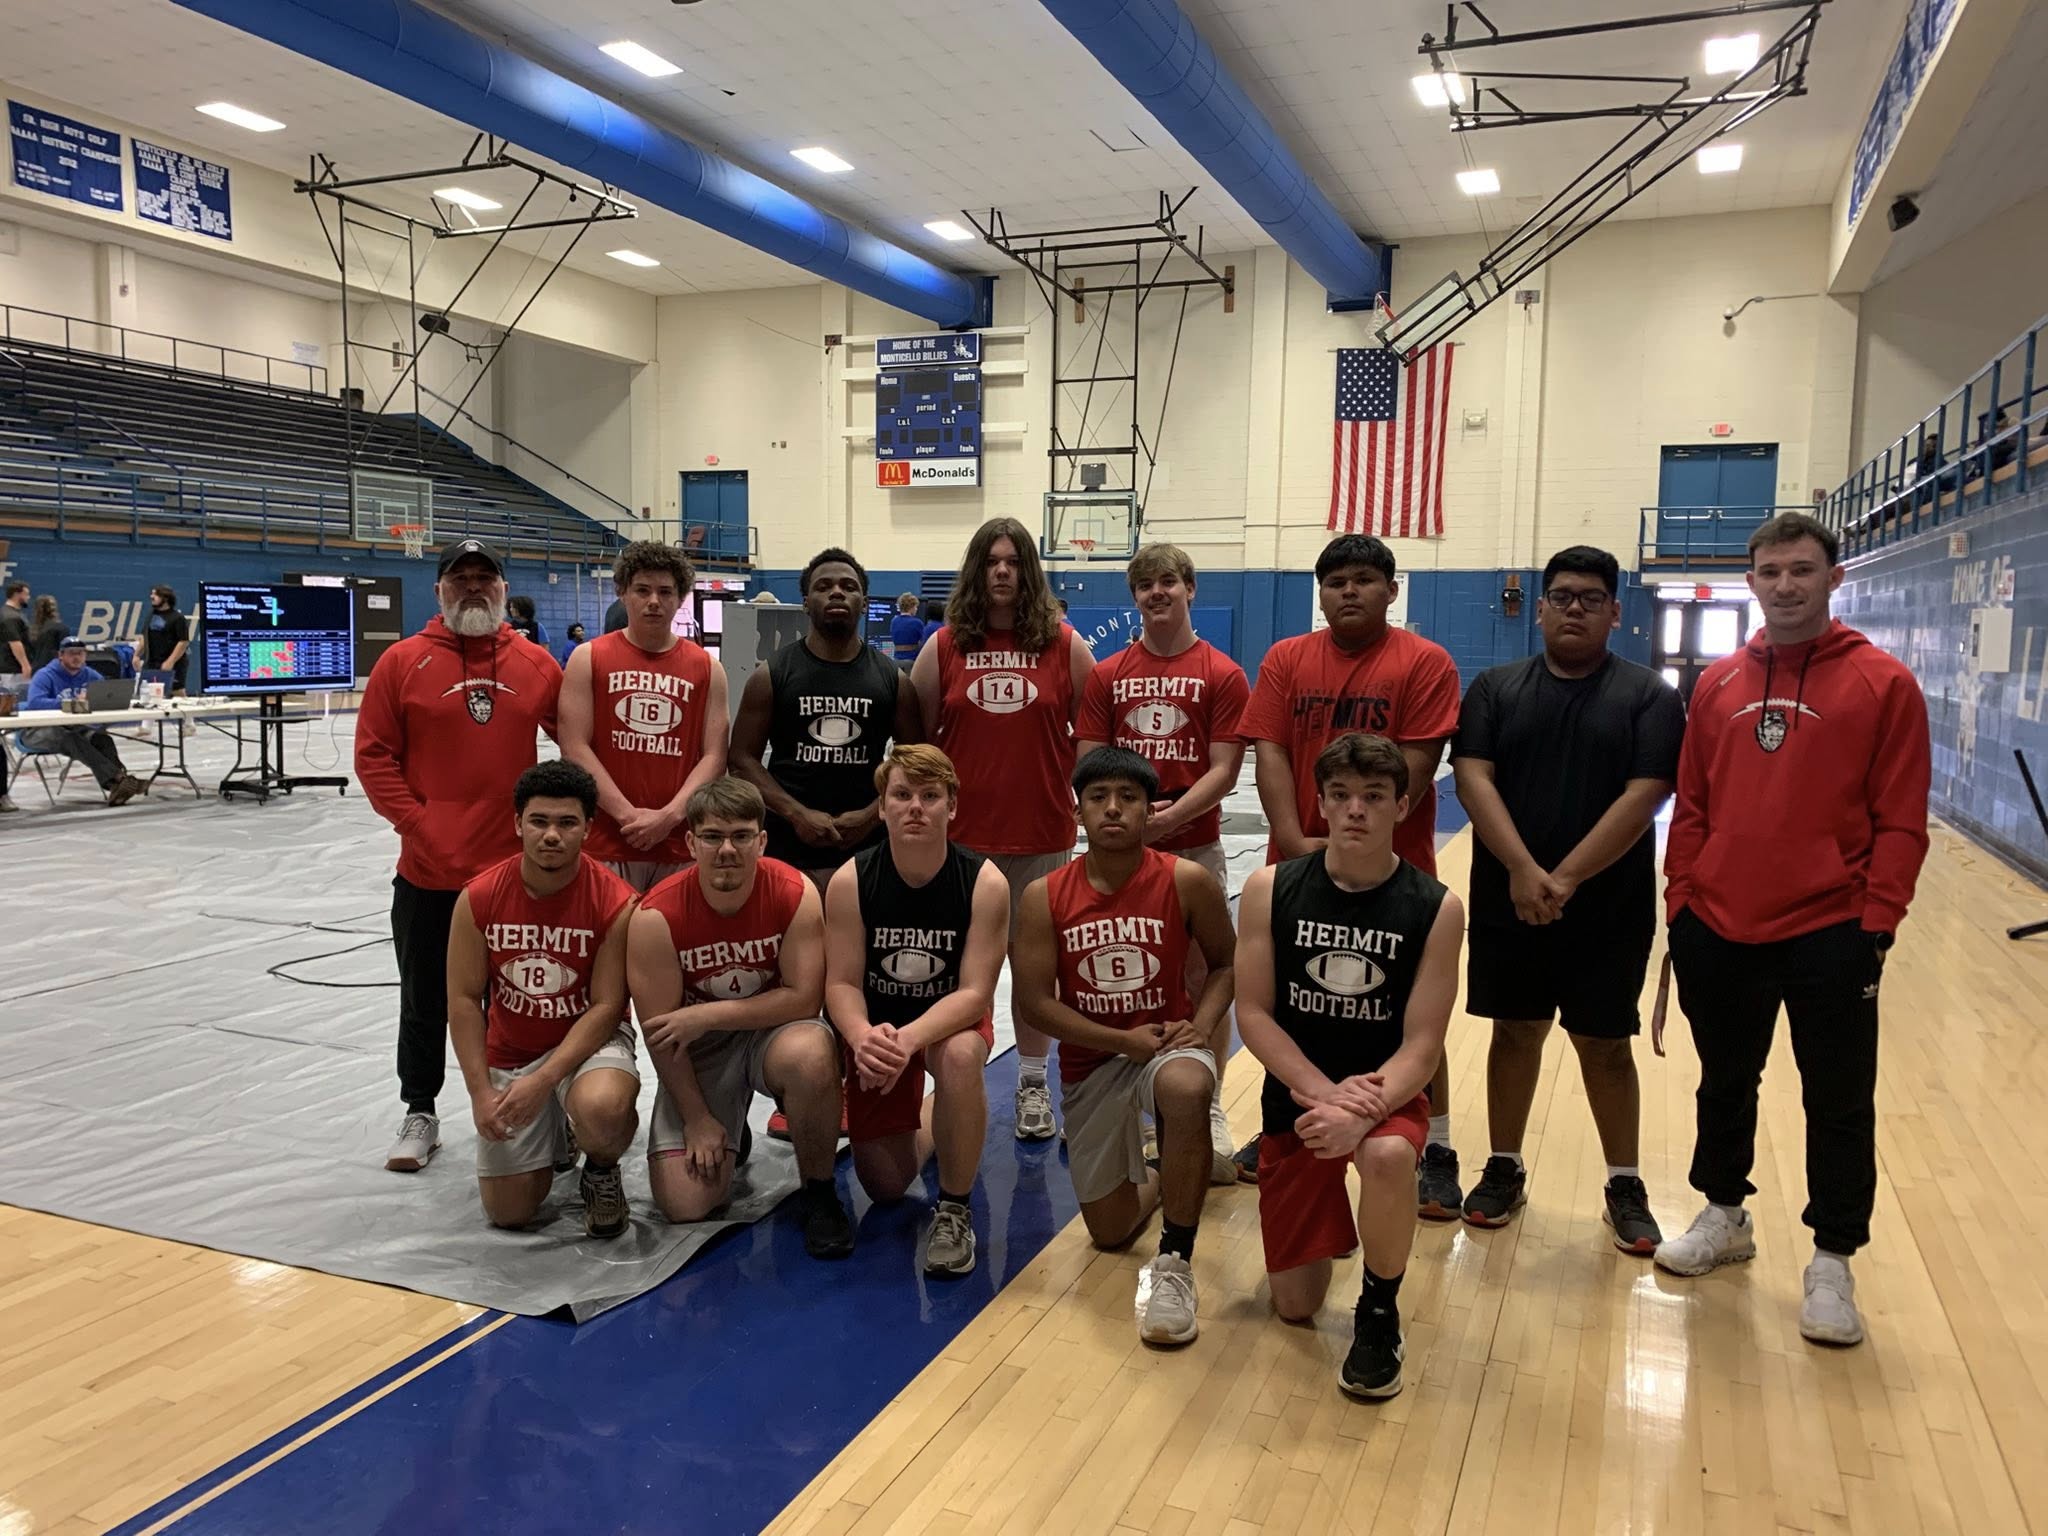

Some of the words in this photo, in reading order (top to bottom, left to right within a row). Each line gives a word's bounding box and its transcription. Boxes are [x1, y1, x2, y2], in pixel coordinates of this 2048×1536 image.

[41, 135, 78, 153] DISTRICT
[87, 133, 108, 146] GOLF
[892, 341, 911, 350] HOME
[912, 340, 921, 348] OF
[923, 339, 936, 348] THE
[880, 352, 921, 363] MONTICELLO
[922, 351, 948, 360] BILLIES
[880, 376, 898, 385] Home
[953, 372, 976, 382] Guests
[915, 403, 936, 413] period
[879, 447, 894, 455] fouls
[915, 446, 936, 454] player
[959, 444, 975, 453] fouls
[912, 467, 975, 478] McDonald's
[1951, 560, 1986, 605] HOME
[1084, 611, 1144, 651] MONT
[965, 651, 1040, 670] HERMIT
[608, 670, 694, 702] HERMIT
[990, 681, 1014, 700] 14
[1112, 676, 1206, 705] HERMIT
[639, 701, 660, 722] 16
[798, 696, 873, 718] HERMIT
[1152, 712, 1163, 730] 5
[611, 730, 682, 756] FOOTBALL
[795, 742, 870, 765] FOOTBALL
[485, 923, 595, 958] HERMIT
[872, 927, 957, 951] HERMIT
[1063, 916, 1165, 953] HERMIT
[1295, 919, 1404, 960] HERMIT
[679, 933, 782, 972] HERMIT
[521, 966, 545, 988] 18
[1111, 957, 1126, 978] 6
[728, 975, 741, 994] 4
[869, 970, 958, 998] FOOTBALL
[1076, 987, 1166, 1014] FOOTBALL
